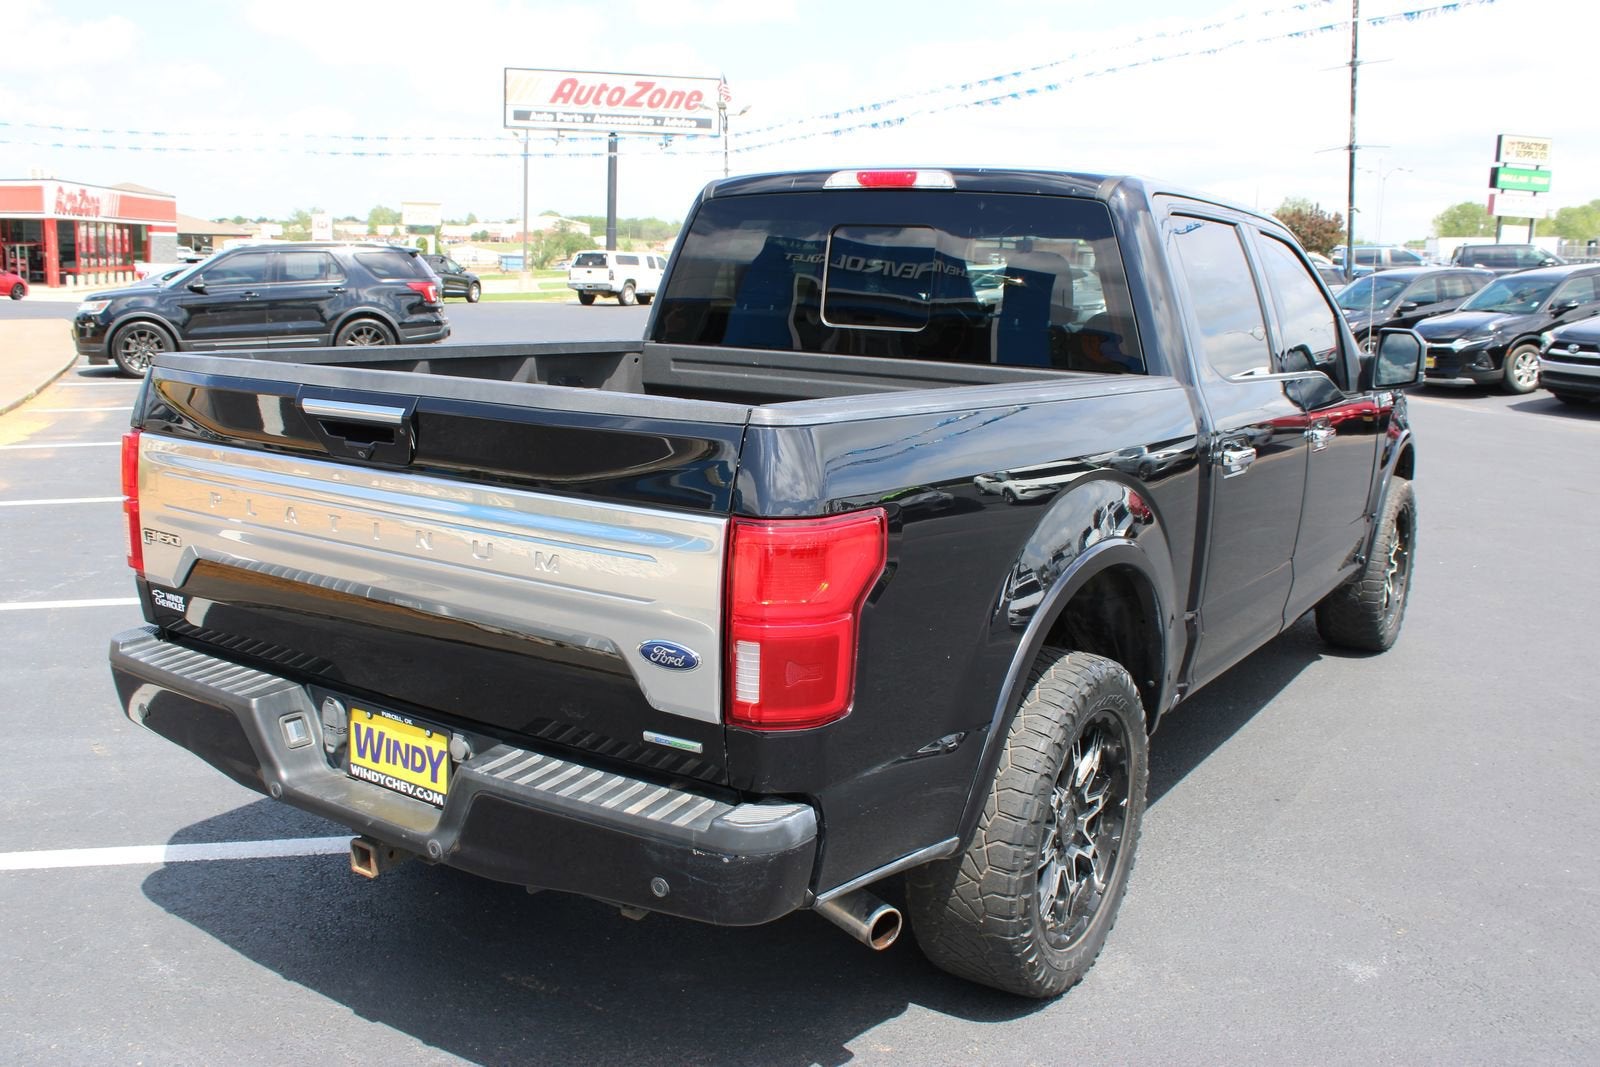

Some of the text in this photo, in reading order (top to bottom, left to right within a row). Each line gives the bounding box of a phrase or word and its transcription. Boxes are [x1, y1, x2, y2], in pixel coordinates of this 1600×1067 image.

[549, 78, 703, 110] AutoZone
[529, 111, 554, 122] Auto
[556, 112, 584, 123] Parts
[593, 114, 654, 126] Accessories
[208, 491, 560, 574] PLATINUM
[155, 597, 185, 612] CHEVROLET
[650, 645, 685, 667] Ford
[354, 722, 447, 784] WINDY
[350, 764, 444, 806] WINDYCHEV.COM
